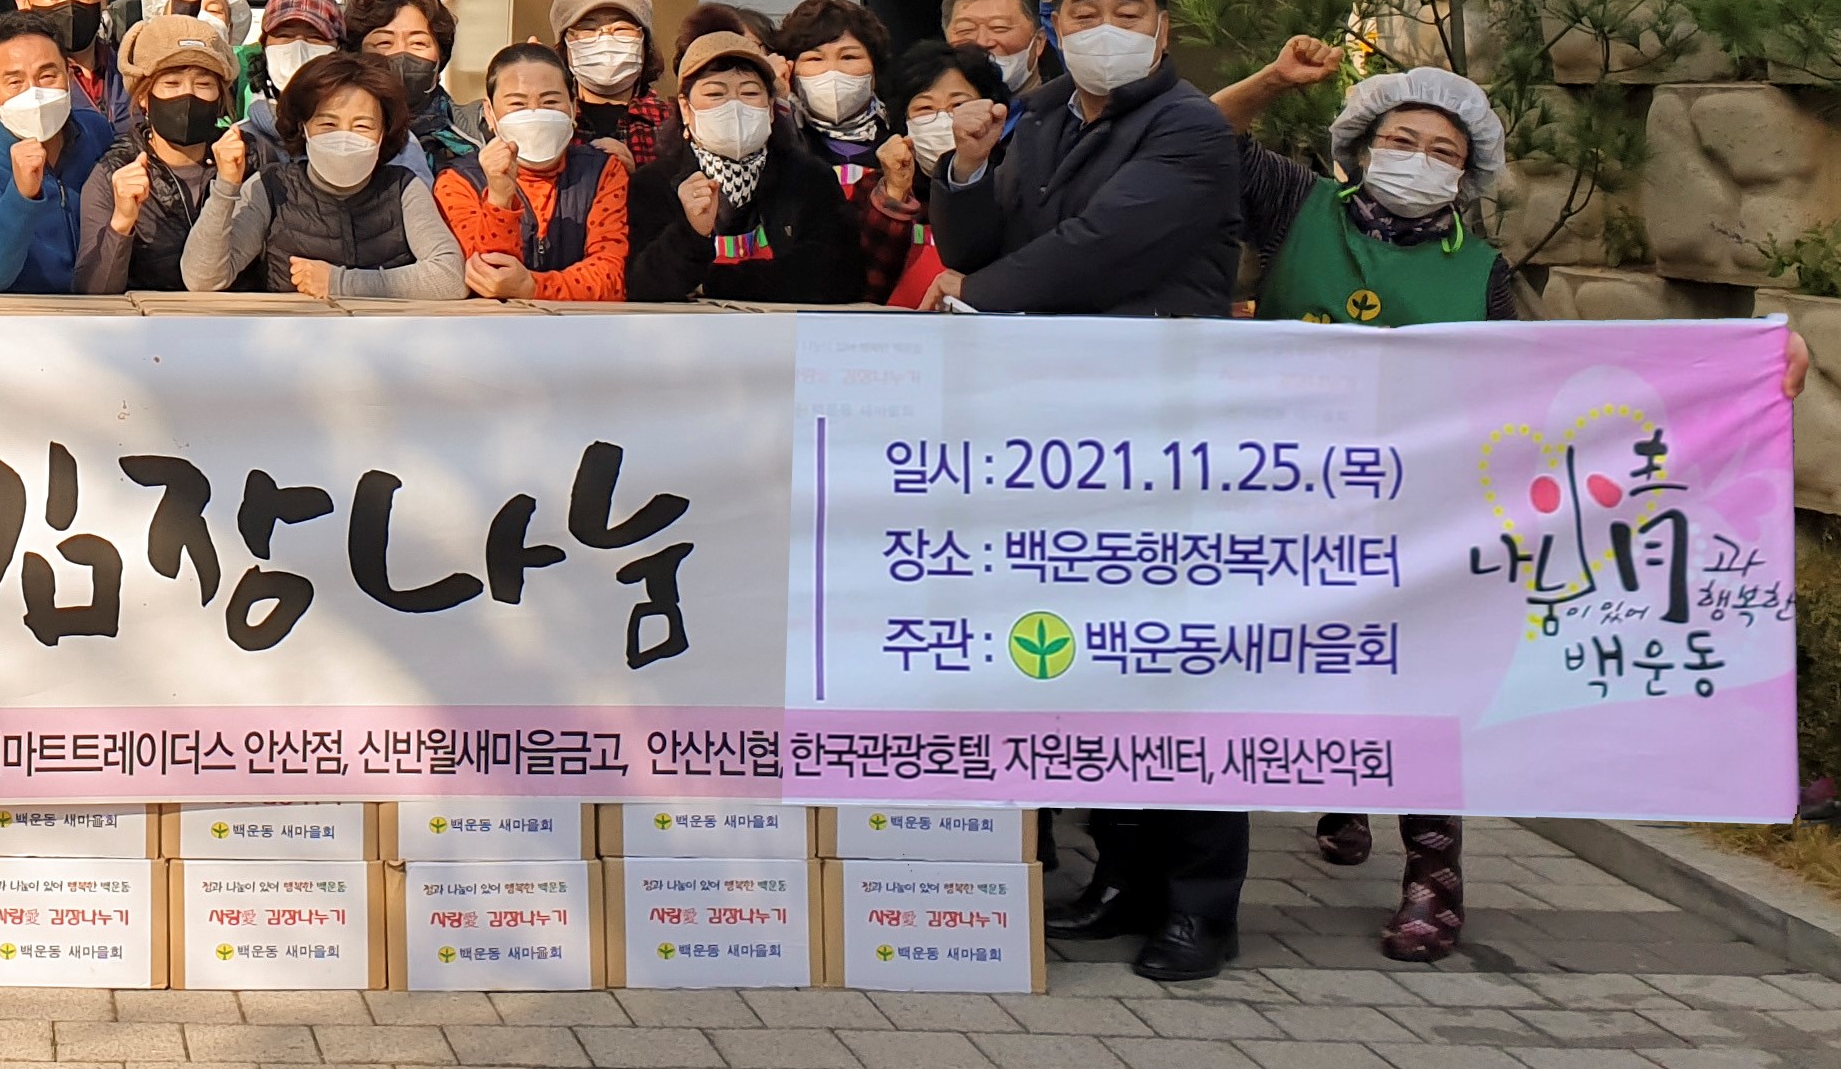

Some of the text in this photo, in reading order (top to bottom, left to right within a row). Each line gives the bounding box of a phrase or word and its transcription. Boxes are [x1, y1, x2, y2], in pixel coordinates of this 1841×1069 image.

[887, 441, 970, 494] 일시
[1005, 439, 1402, 500] 2021.11.25.(목)
[883, 529, 973, 581] 장소
[1006, 530, 1399, 587] 백운동행정복지센터
[883, 618, 974, 671] 주관
[1086, 621, 1398, 675] 백운동새마을회
[1564, 629, 1726, 699] 백운동
[1222, 738, 1393, 787] 새원산악회
[14, 810, 119, 827] 백운동 새마을회
[451, 818, 552, 832] 백운동 새마을회
[676, 815, 778, 828] 백운동 새마을회
[891, 816, 993, 832] 백운동 새마을회
[233, 824, 334, 838] 백운동 새마을회
[49, 909, 128, 925] 김장나누기
[265, 909, 345, 925] 김장나누기
[487, 910, 566, 927] 김장나누기
[707, 908, 786, 924] 김장나누기
[926, 911, 1006, 928] 김장나누기
[21, 945, 122, 959] 백운동 새마을회
[238, 945, 339, 958] 백운동 새마을회
[460, 946, 561, 960] 백운동 새마을회
[679, 944, 780, 957] 백운동 새마을회
[898, 947, 1001, 961] 백운동 새마을회
